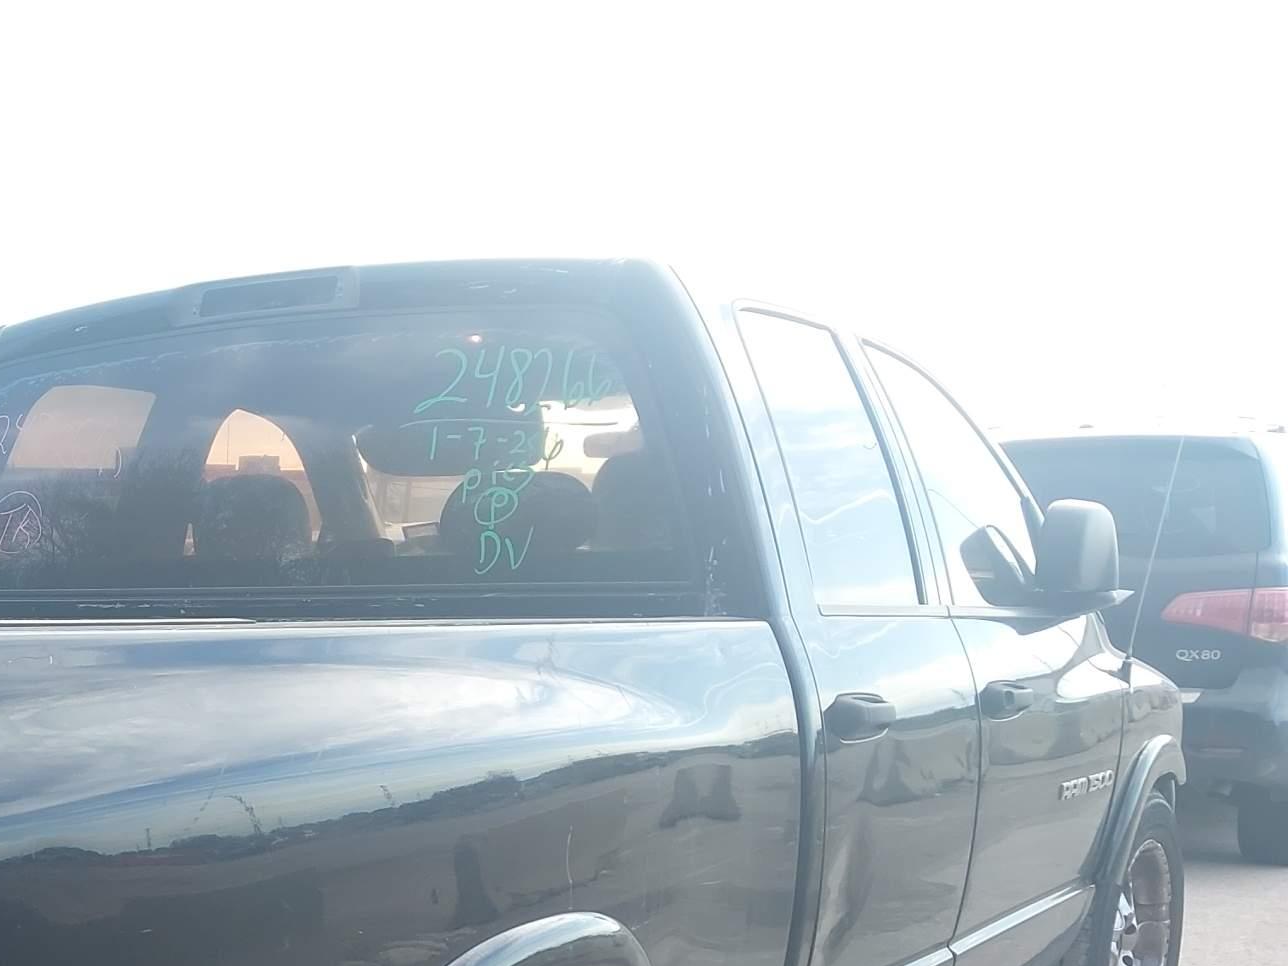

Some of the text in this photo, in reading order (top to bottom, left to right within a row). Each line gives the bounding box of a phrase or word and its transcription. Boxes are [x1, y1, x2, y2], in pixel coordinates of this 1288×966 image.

[474, 525, 534, 574] DV
[1175, 649, 1221, 662] QX80
[1059, 776, 1089, 801] RAM
